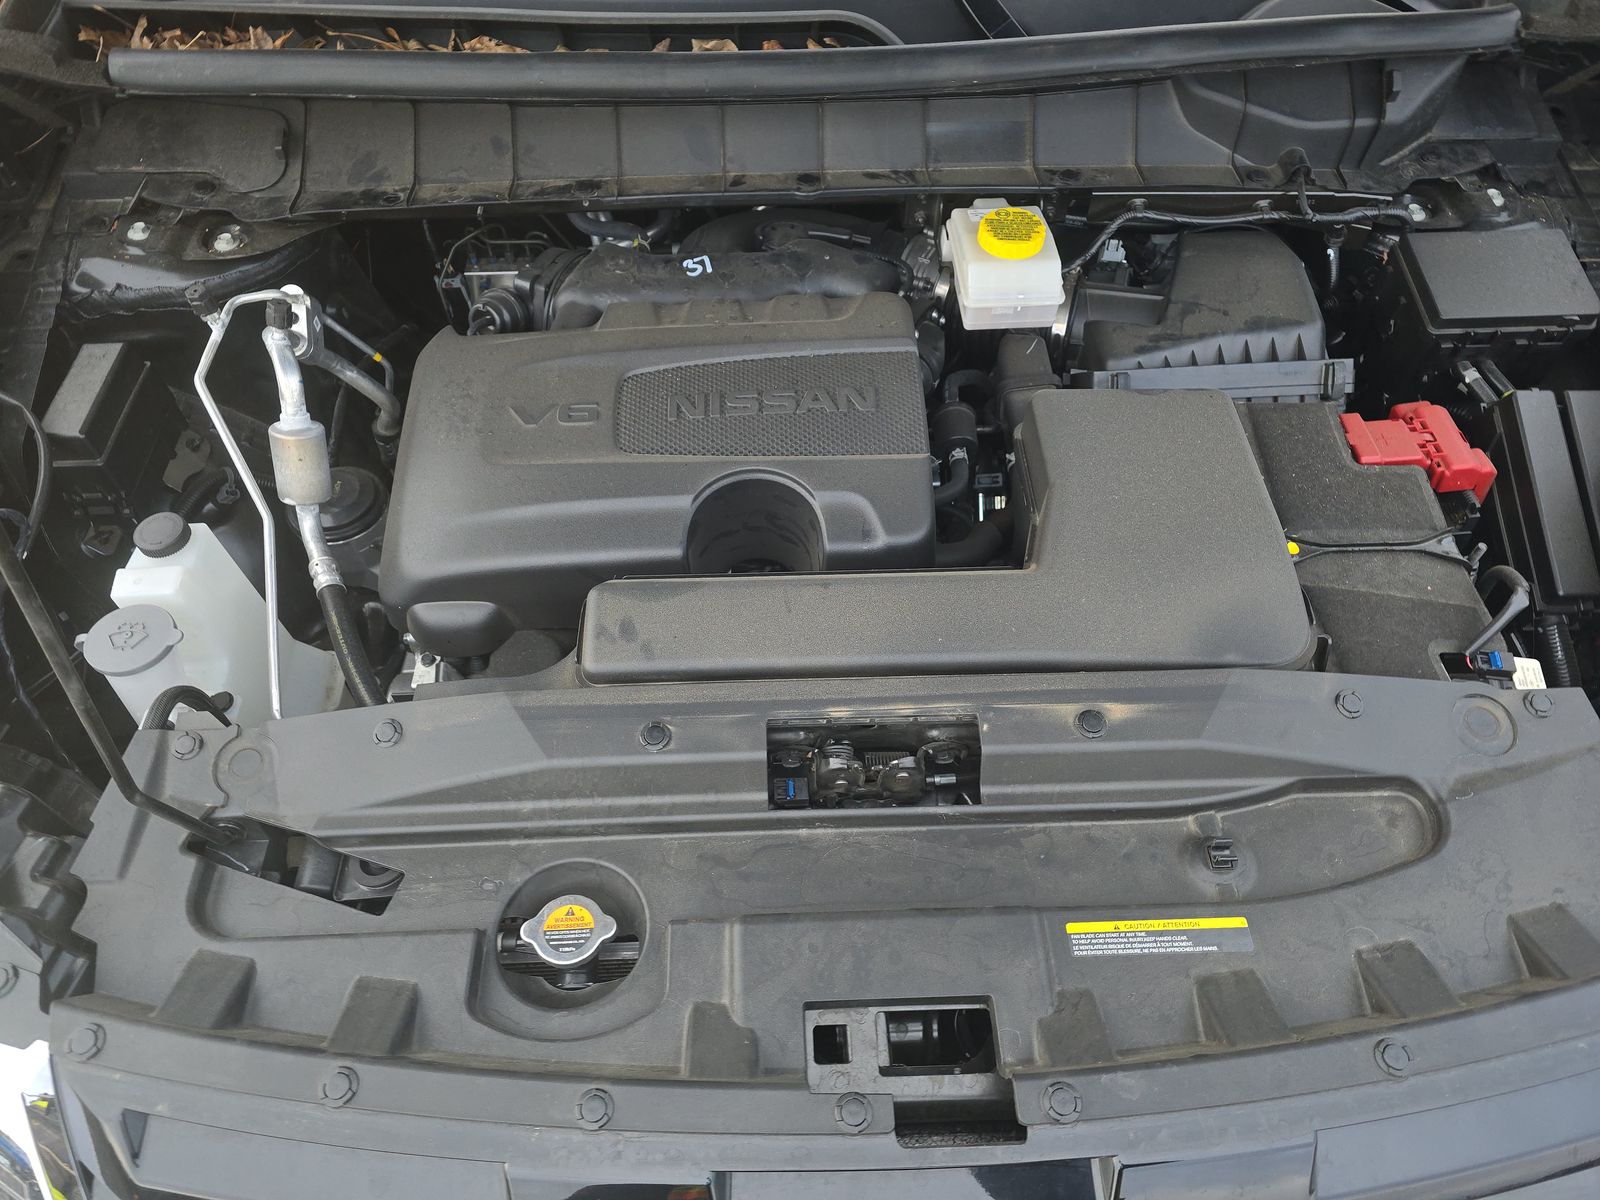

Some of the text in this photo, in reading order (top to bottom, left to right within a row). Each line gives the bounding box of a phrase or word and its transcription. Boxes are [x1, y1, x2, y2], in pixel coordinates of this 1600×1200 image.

[682, 255, 713, 277] 37
[507, 385, 879, 427] V6 NISSAN
